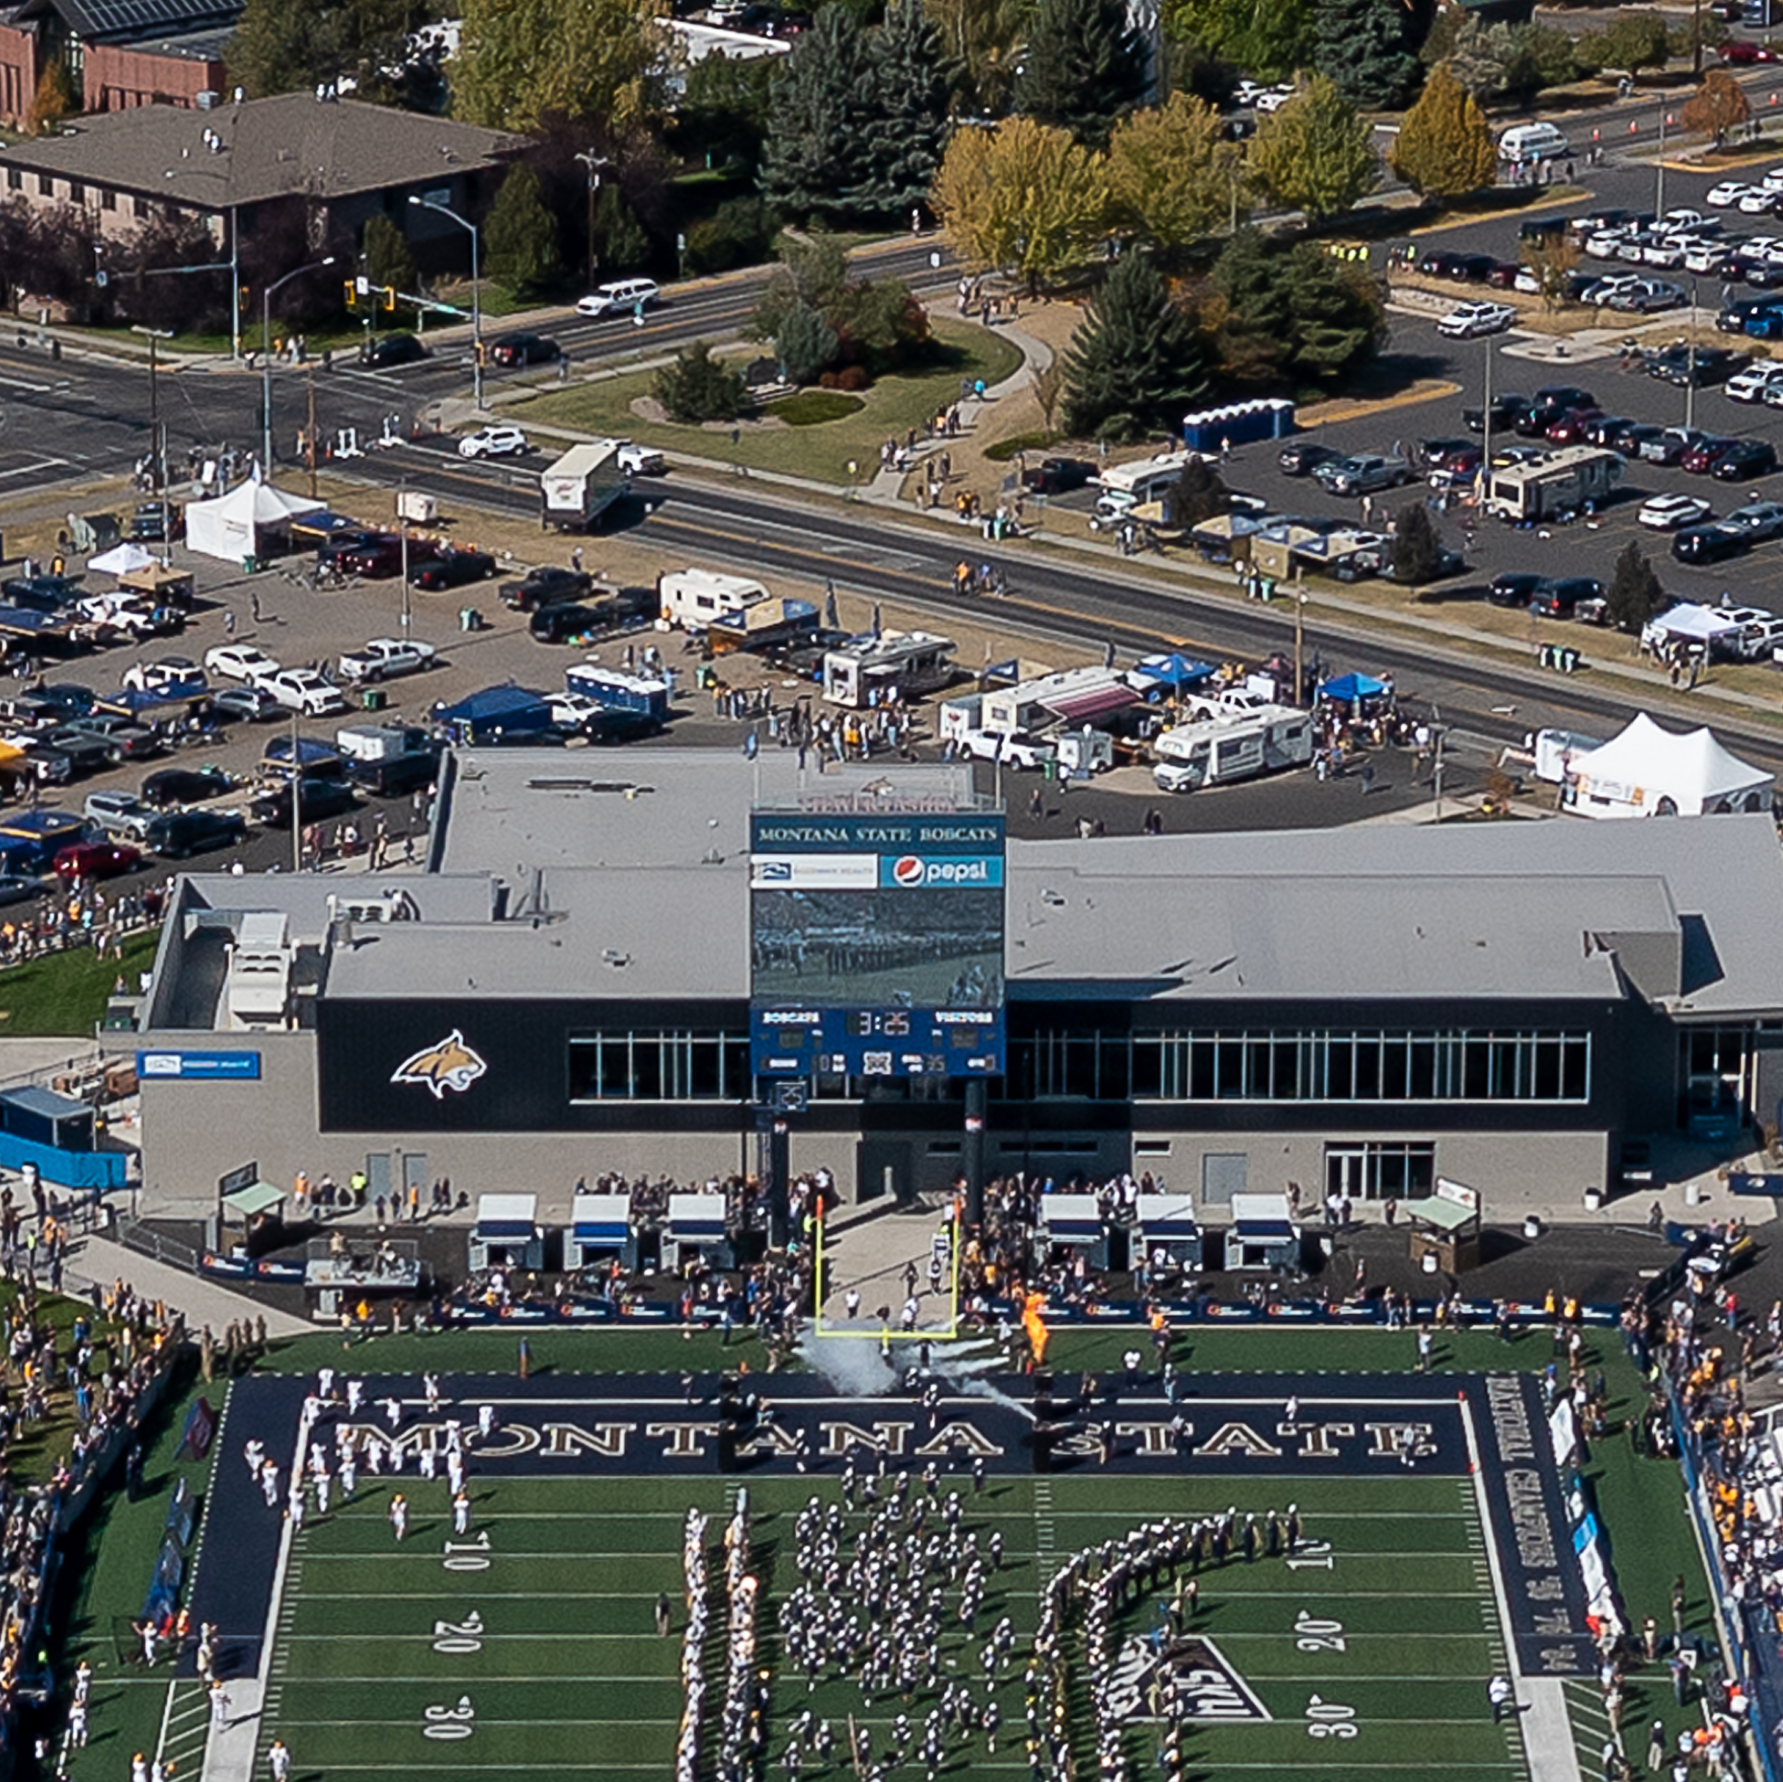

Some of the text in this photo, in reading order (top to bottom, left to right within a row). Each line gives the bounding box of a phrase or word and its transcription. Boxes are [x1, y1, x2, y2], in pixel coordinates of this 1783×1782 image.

[758, 827, 998, 842] MONTANA STATE BOBCATS
[926, 861, 988, 884] pepsi
[1049, 1422, 1439, 1457] STATE
[443, 1538, 490, 1572] 10
[433, 1620, 483, 1654] 20
[1298, 1618, 1346, 1653] 20
[424, 1705, 474, 1740] 30
[1308, 1702, 1359, 1739] 30
